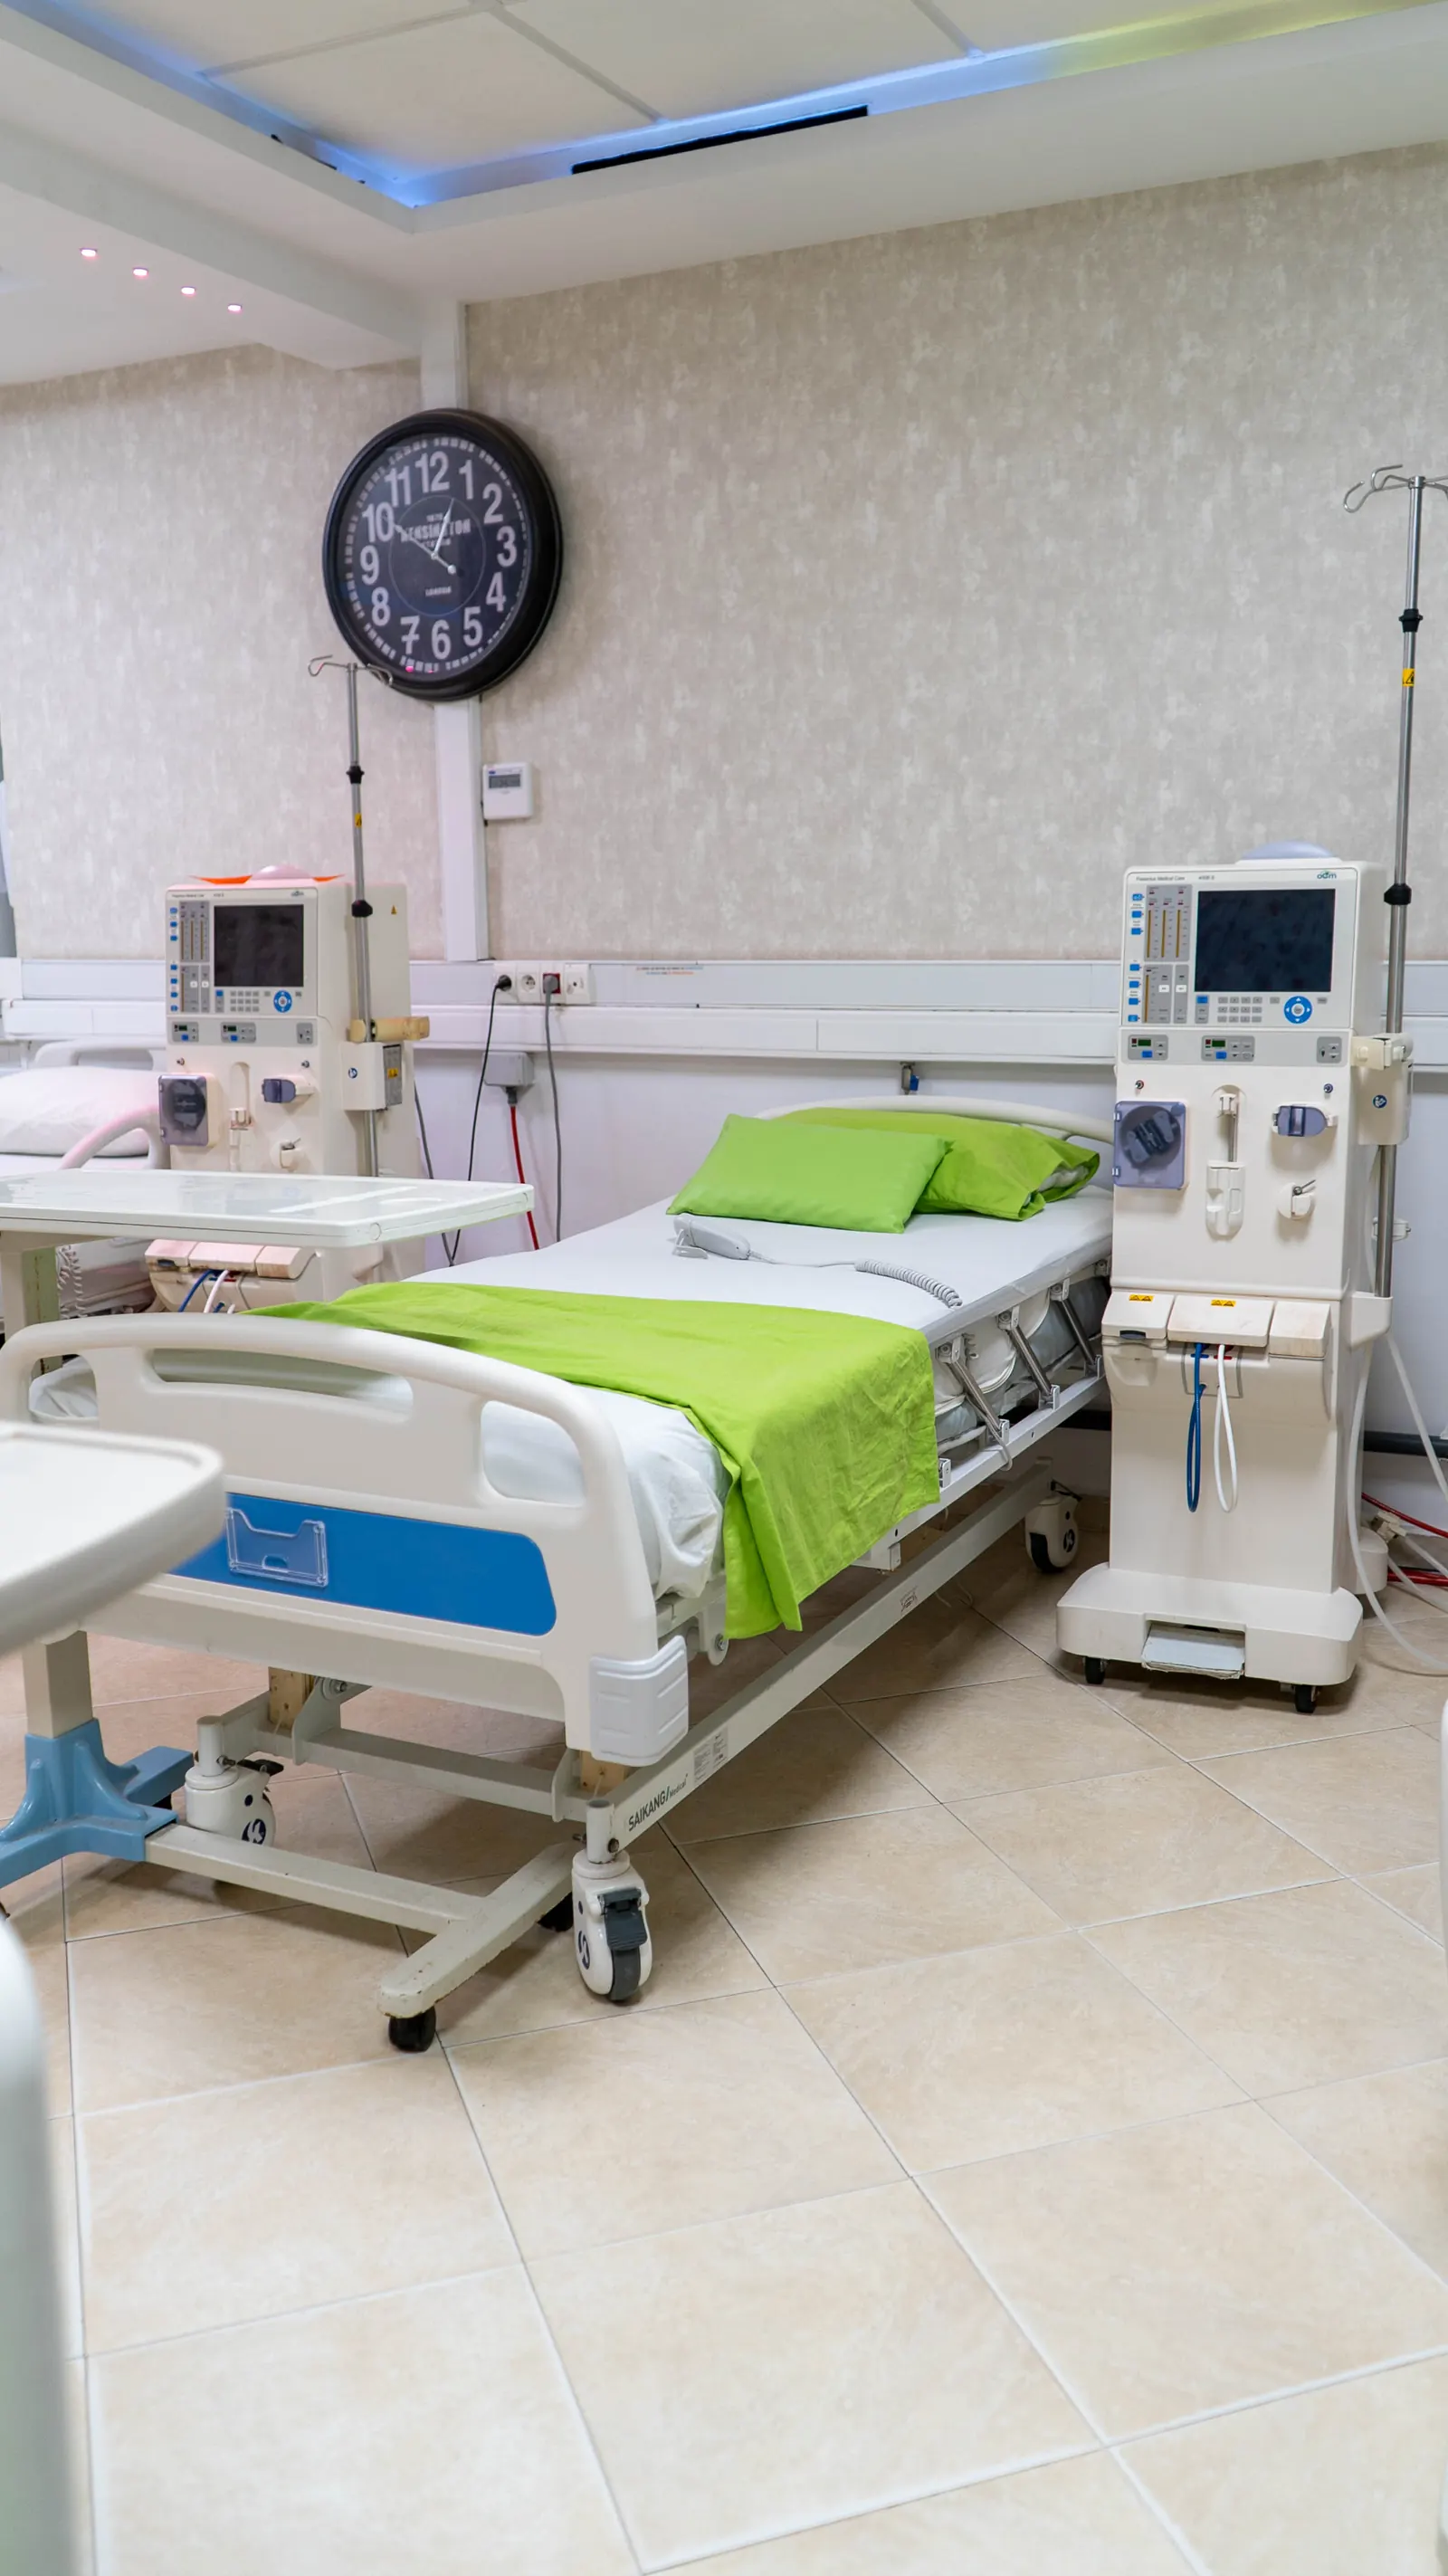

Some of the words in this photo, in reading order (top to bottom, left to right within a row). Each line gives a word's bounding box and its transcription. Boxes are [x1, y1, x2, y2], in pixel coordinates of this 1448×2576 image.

[385, 466, 411, 507] 11
[415, 452, 450, 493] 12
[459, 460, 473, 500] 1
[362, 501, 395, 543] 10
[482, 483, 503, 524] 2
[360, 545, 379, 585] 9
[497, 526, 517, 568] 3
[371, 587, 390, 626] 8
[486, 572, 506, 612] 4
[401, 615, 420, 654] 7
[431, 620, 451, 660] 6
[463, 606, 482, 646] 5
